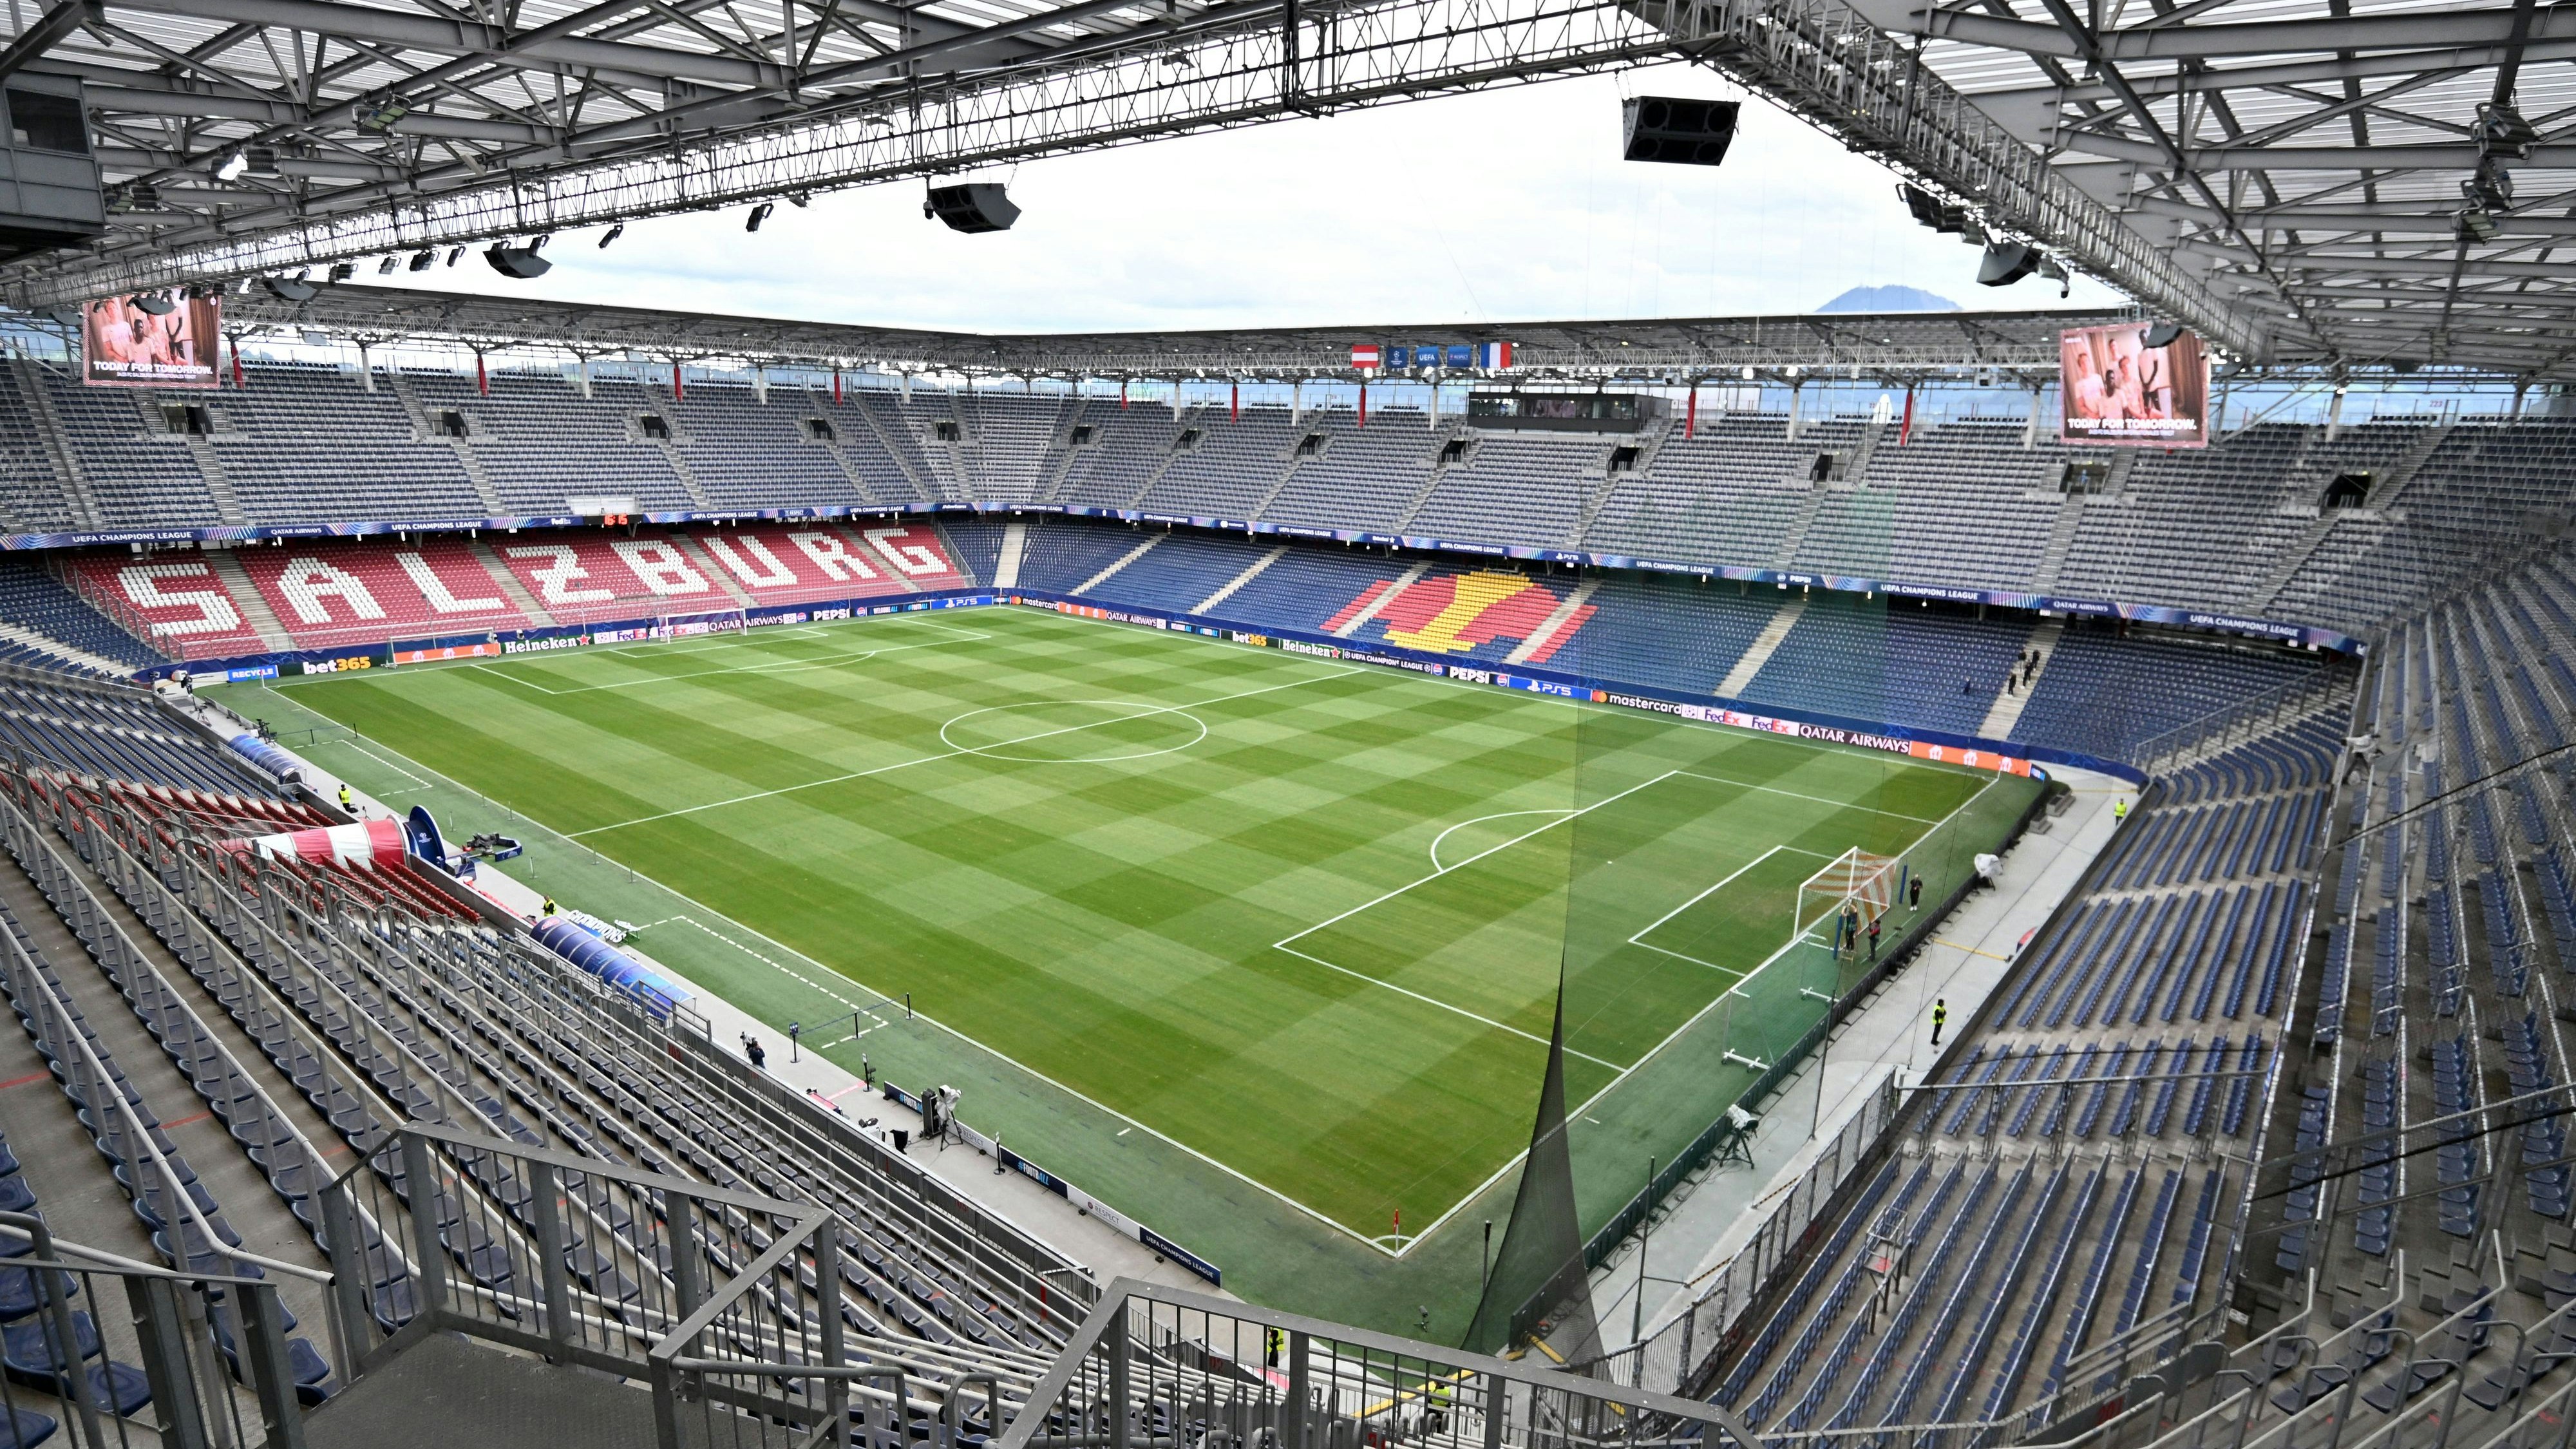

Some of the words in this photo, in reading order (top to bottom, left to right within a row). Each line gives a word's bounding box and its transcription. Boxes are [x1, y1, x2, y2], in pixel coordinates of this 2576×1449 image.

[93, 361, 129, 372] TODAY
[131, 363, 152, 372] FOR
[154, 364, 213, 375] TOMORROW.
[2068, 418, 2101, 429] TODAY
[2102, 419, 2124, 429] FOR
[2125, 419, 2197, 430] TOMORROW.
[603, 513, 629, 526] 16:15
[72, 535, 99, 543] UEFA
[100, 533, 156, 542] CHAMPIONS
[157, 531, 193, 540] LEAGUE
[1291, 527, 1314, 536] CHAMPIONS
[1454, 543, 1483, 552] CHAMPIONS
[1653, 562, 1689, 572] CHAMPIONS
[1690, 565, 1714, 574] LEAGUE
[118, 528, 947, 638] SALZBURG
[1790, 574, 1812, 583] PEPSI
[1880, 583, 1900, 592] UEFA
[1902, 585, 1946, 598] CHAMPIONS
[1947, 590, 1979, 600] LEAGUE
[956, 598, 978, 606] PS5
[1023, 598, 1059, 610] mastercard
[2053, 600, 2078, 609] QATAR
[2078, 603, 2108, 612] AIRWAYS
[709, 620, 742, 632] QATAR
[746, 614, 784, 627] AIRWAYS
[813, 609, 850, 621] PEPSI
[1106, 612, 1128, 623] QATAR
[1130, 614, 1157, 627] AIRWAYS
[2190, 614, 2215, 625] UEFA
[2215, 617, 2269, 632] CHAMPIONS
[2269, 624, 2300, 637] LEAGUE
[617, 629, 647, 641] FedEx
[1232, 631, 1267, 647] bet365
[504, 638, 578, 654] Heineken
[1282, 639, 1331, 658] Heineken
[303, 656, 371, 675] bet365
[1351, 653, 1366, 661] UEFA
[1366, 655, 1399, 666] CHAMPIONS
[1401, 661, 1423, 671] LEAGUE
[232, 668, 274, 678] RECYCLE
[1449, 666, 1490, 685] PEPSI
[1542, 683, 1572, 696] PS5
[1609, 694, 1682, 715] mastercard
[1705, 710, 1740, 726] FedEx
[1752, 715, 1789, 734] FedEx
[1800, 724, 1844, 743] QATAR
[1850, 733, 1909, 753] AIRWAYS
[565, 909, 627, 943] CHAMPIONS
[899, 1093, 923, 1113] #FOOTBAL
[963, 1130, 983, 1148] RESPECT
[1018, 1160, 1050, 1186] #FOOTBALL
[1094, 1206, 1119, 1224] RESPECT
[1146, 1235, 1160, 1247] UEFA
[1160, 1243, 1192, 1266] CHAMPIONS
[1192, 1261, 1214, 1278] LEAGUE
